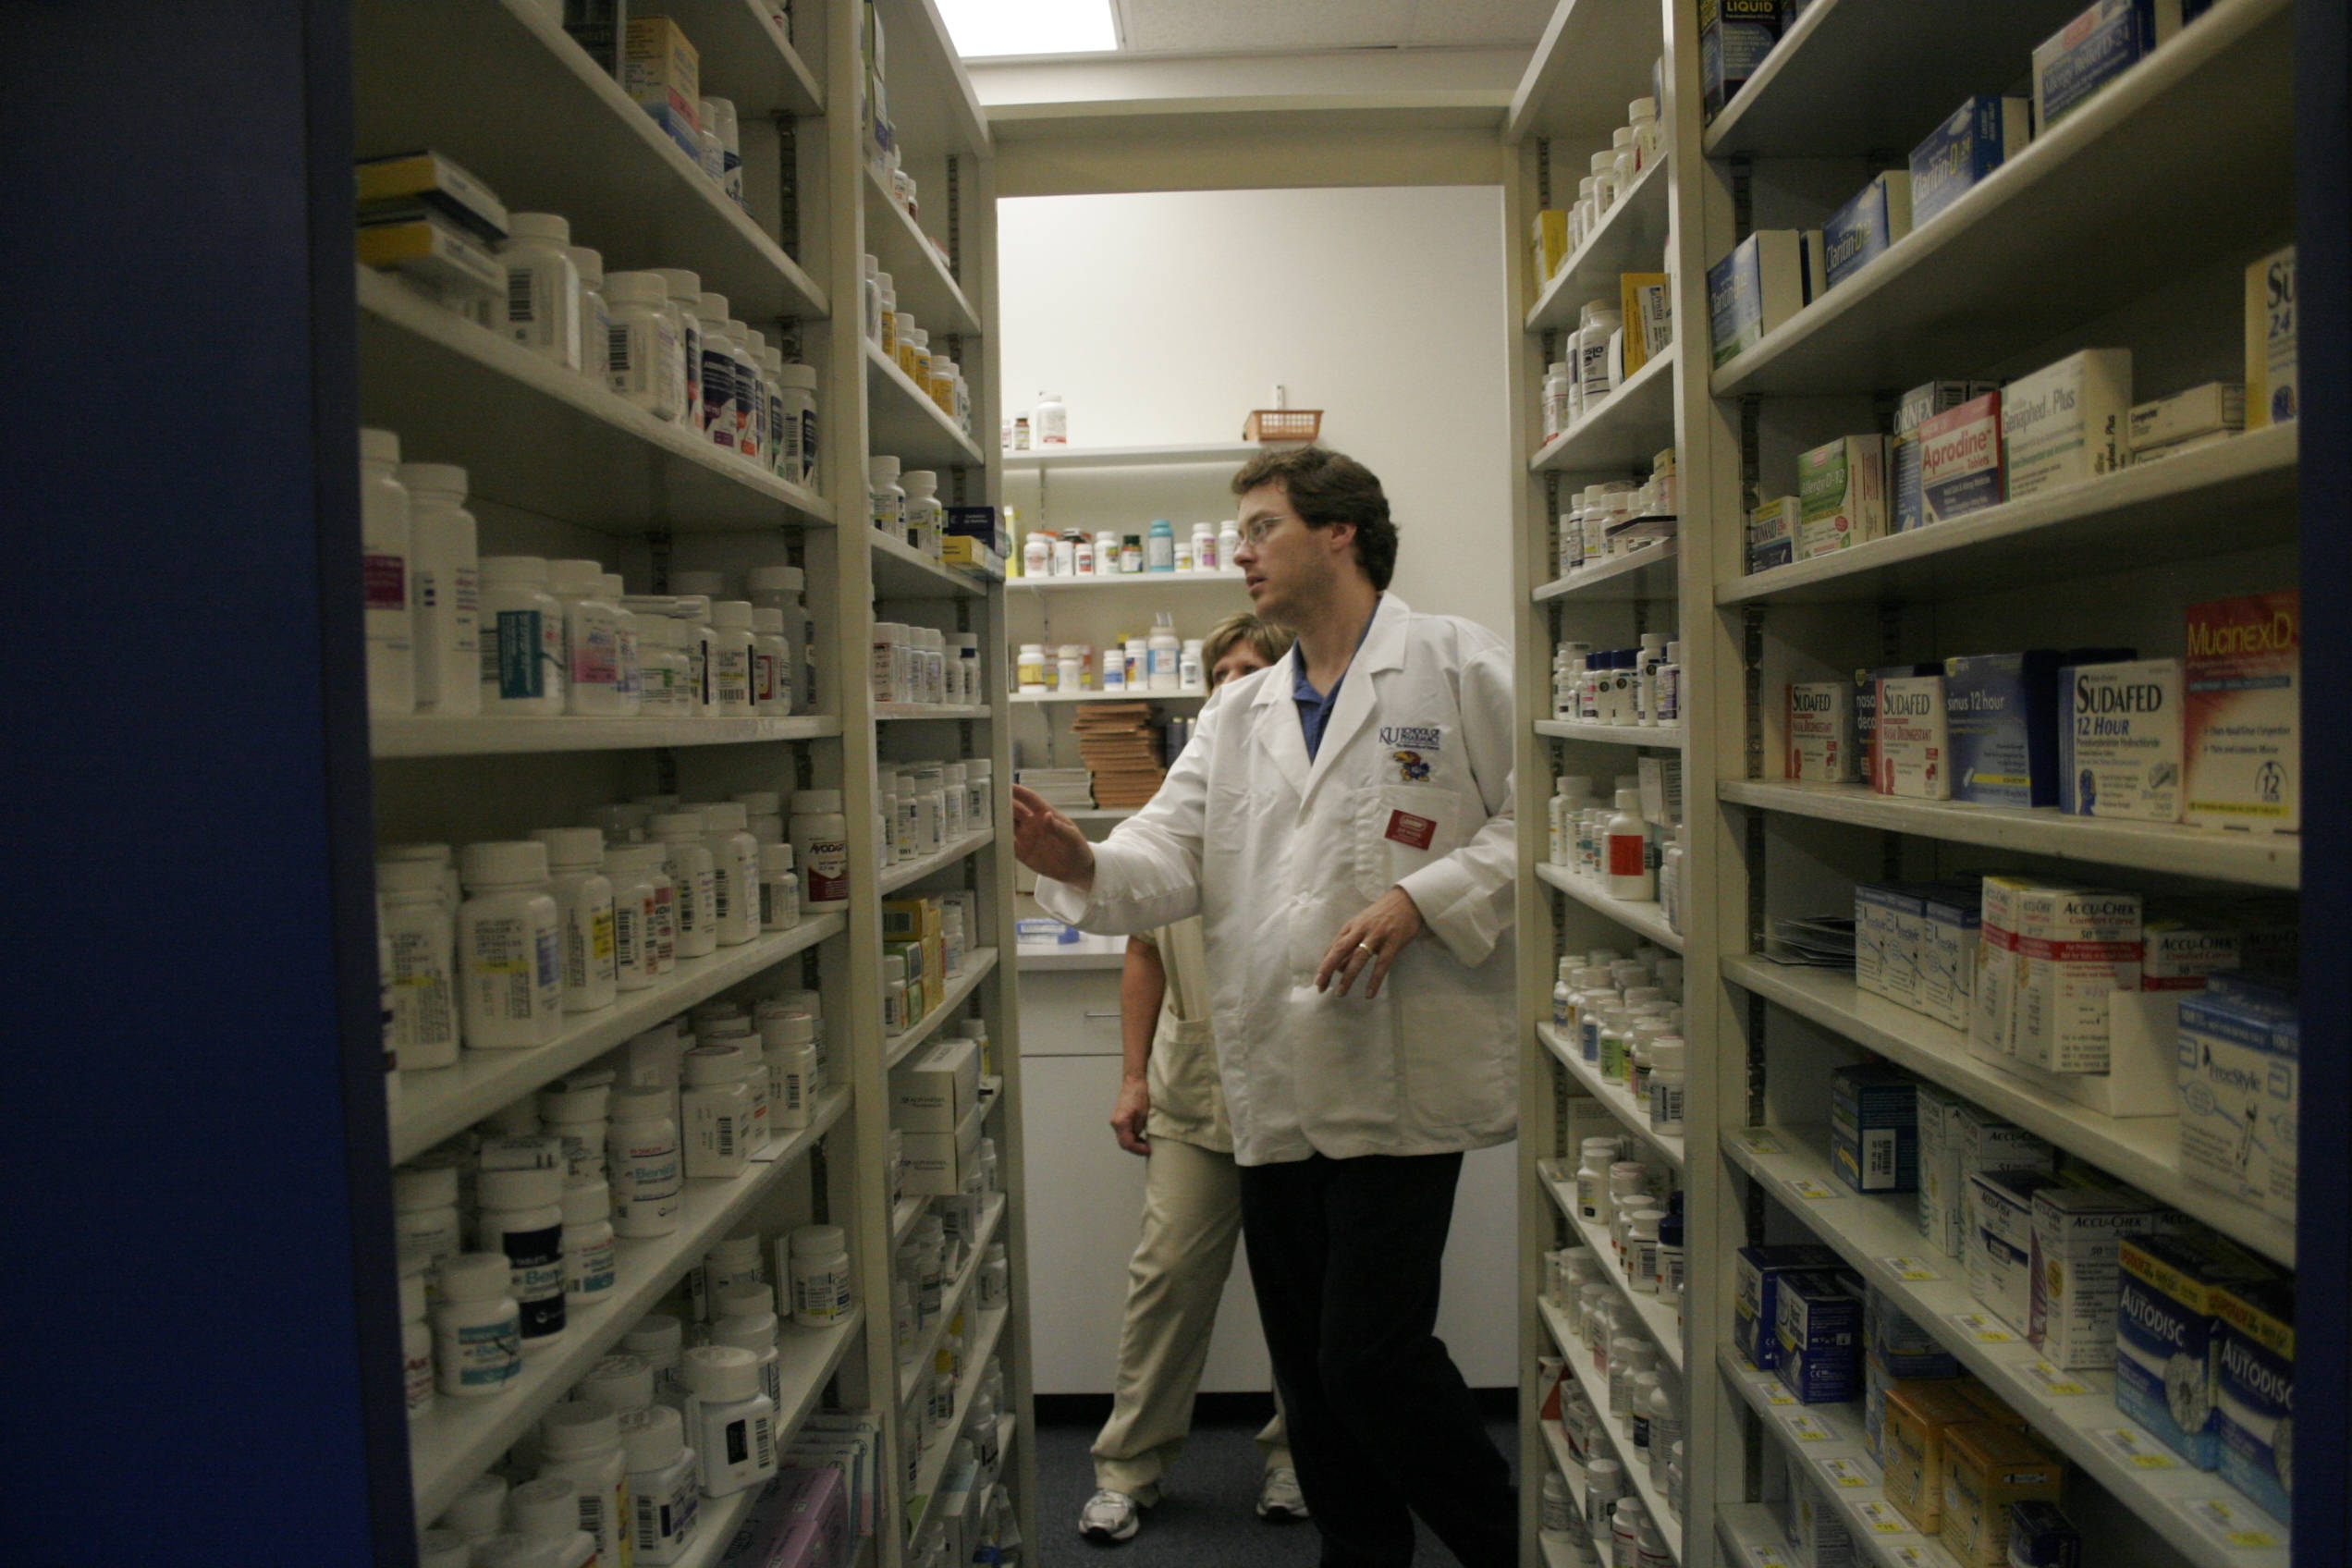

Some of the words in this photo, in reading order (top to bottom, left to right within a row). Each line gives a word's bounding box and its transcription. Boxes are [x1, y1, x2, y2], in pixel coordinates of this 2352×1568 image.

[1726, 0, 1773, 12] LIQUID
[2052, 387, 2075, 414] Plus
[1922, 429, 1988, 475] Aprodine
[1792, 686, 1831, 712] SUDAFED
[1883, 685, 1930, 716] SUDAFED
[1947, 692, 1968, 712] sinus
[1970, 692, 1981, 711] 12
[1982, 690, 2005, 711] hour
[2076, 674, 2162, 714] SUDAFED
[1378, 727, 1400, 745] KU
[2076, 717, 2090, 736] 12
[2094, 717, 2129, 736] HOUR
[2263, 774, 2280, 794] 12
[2064, 900, 2136, 916] ACCU-CHEK
[2120, 1284, 2187, 1347] AUTODISC
